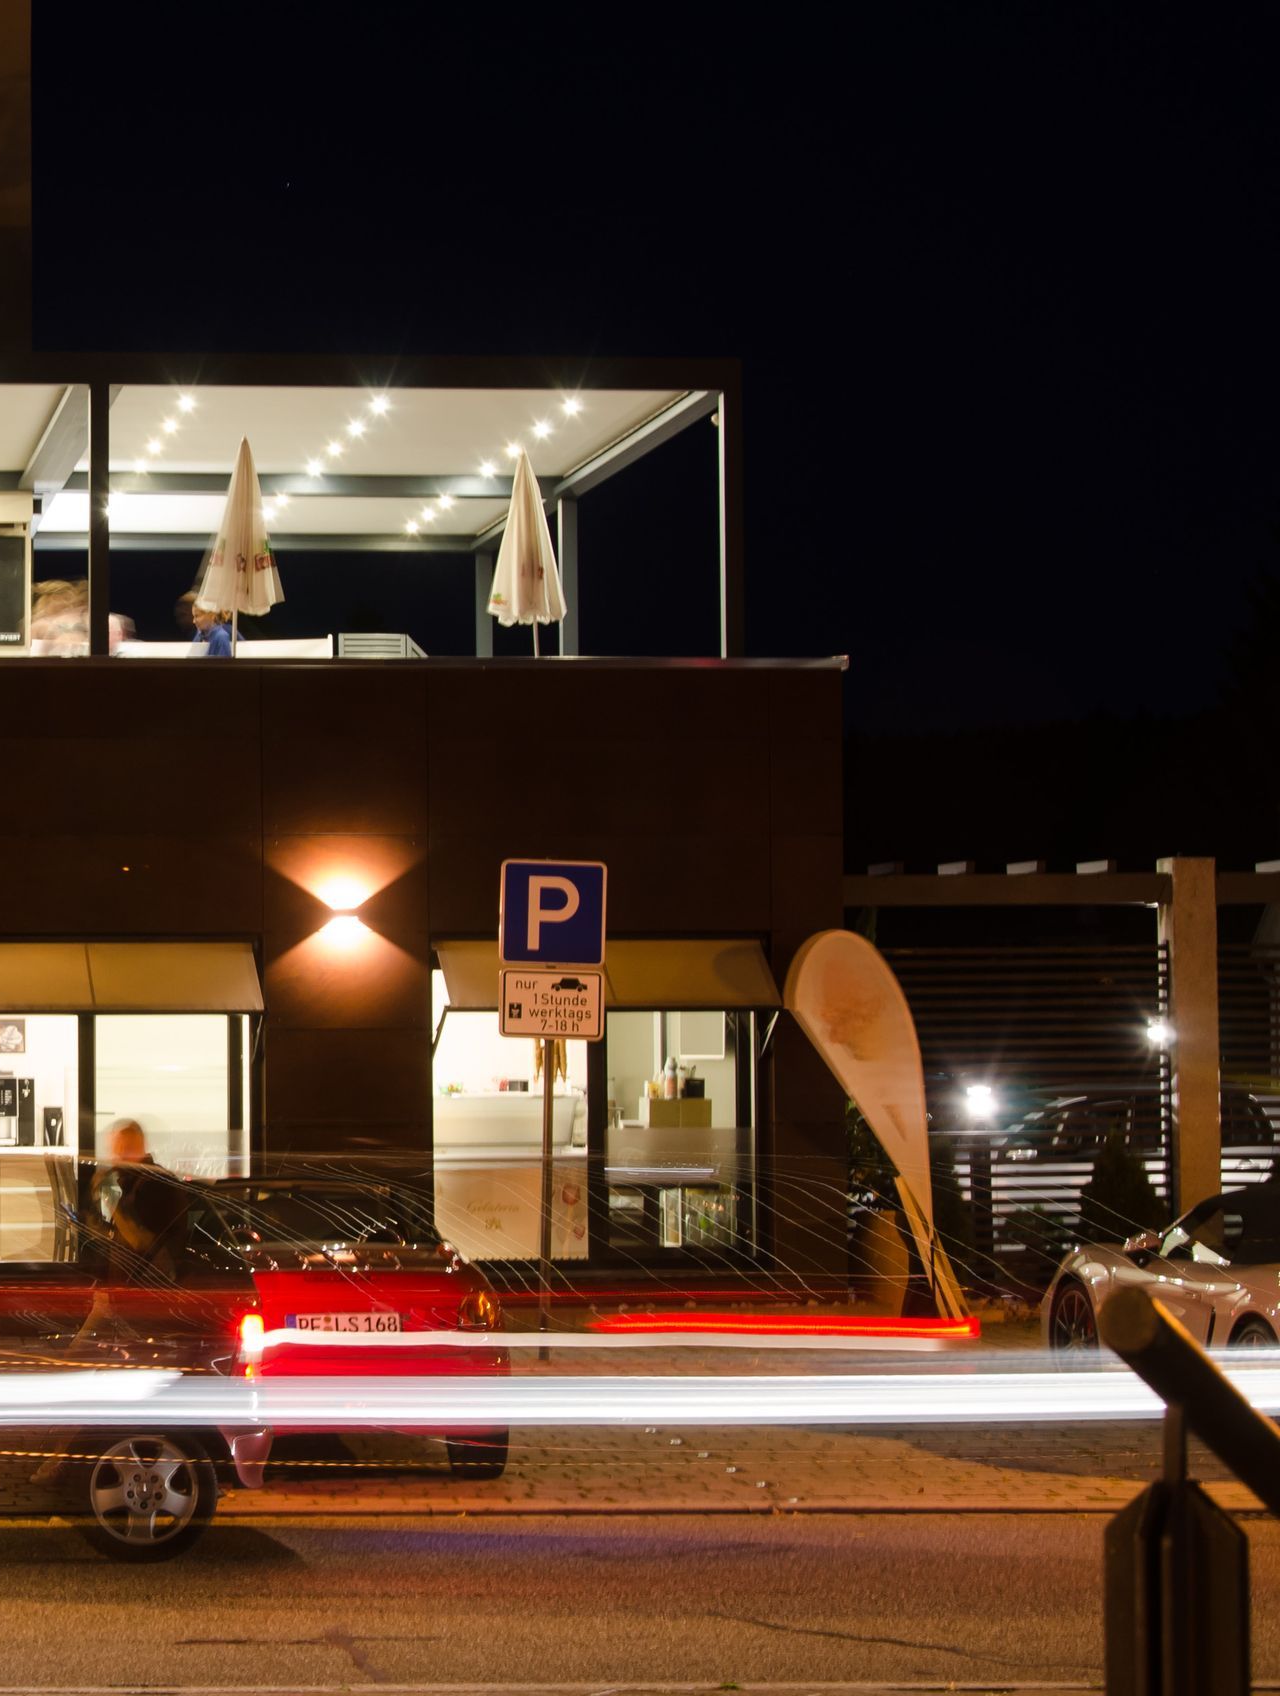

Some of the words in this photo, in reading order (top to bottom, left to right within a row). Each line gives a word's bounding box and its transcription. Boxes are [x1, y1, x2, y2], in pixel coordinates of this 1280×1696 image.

[526, 875, 580, 951] P
[515, 979, 539, 990] nur
[540, 993, 588, 1006] Stunde
[528, 1006, 592, 1022] werktags
[540, 1019, 567, 1032] 7-18
[571, 1021, 580, 1033] h
[335, 1316, 359, 1333] LS
[363, 1315, 399, 1333] 168
